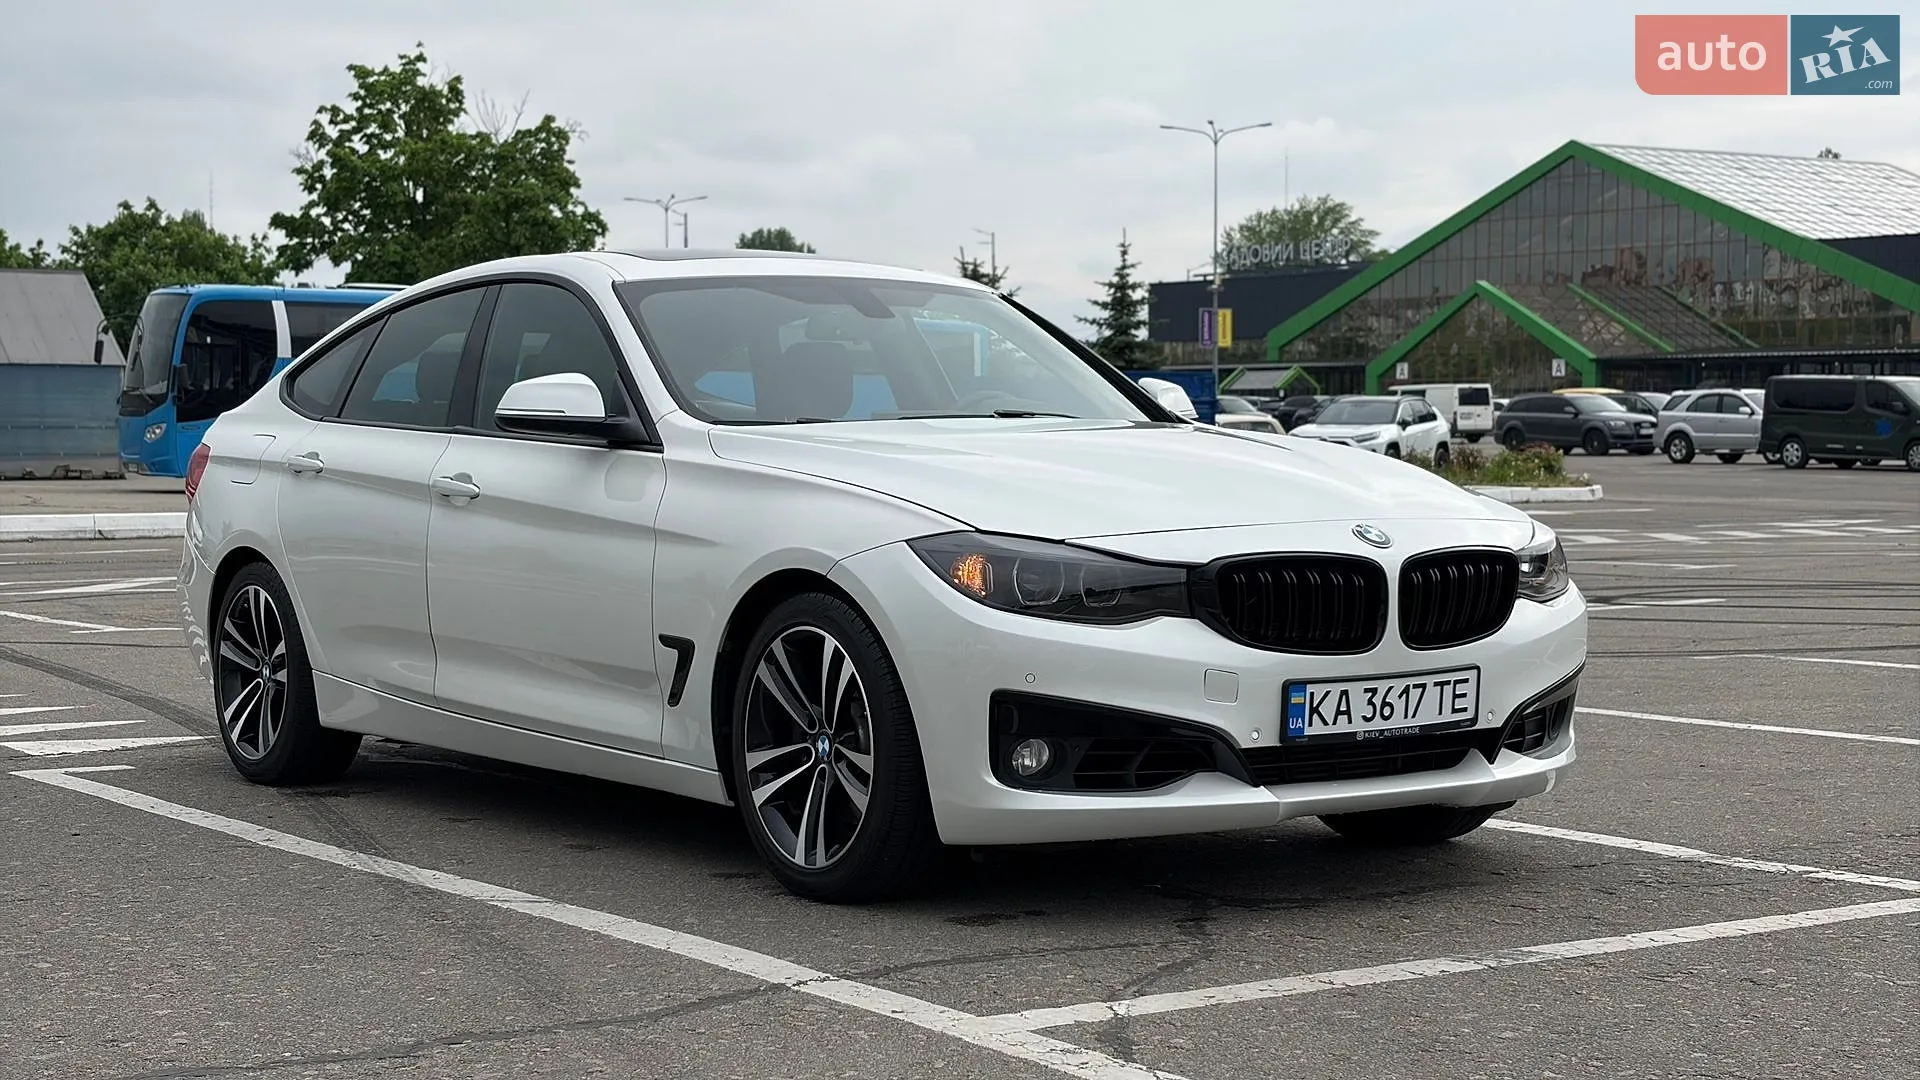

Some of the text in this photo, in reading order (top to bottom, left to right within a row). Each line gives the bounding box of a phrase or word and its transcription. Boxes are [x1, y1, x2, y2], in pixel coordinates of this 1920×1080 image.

[1308, 677, 1470, 727] KA 3617 TE
[1289, 717, 1304, 729] UA
